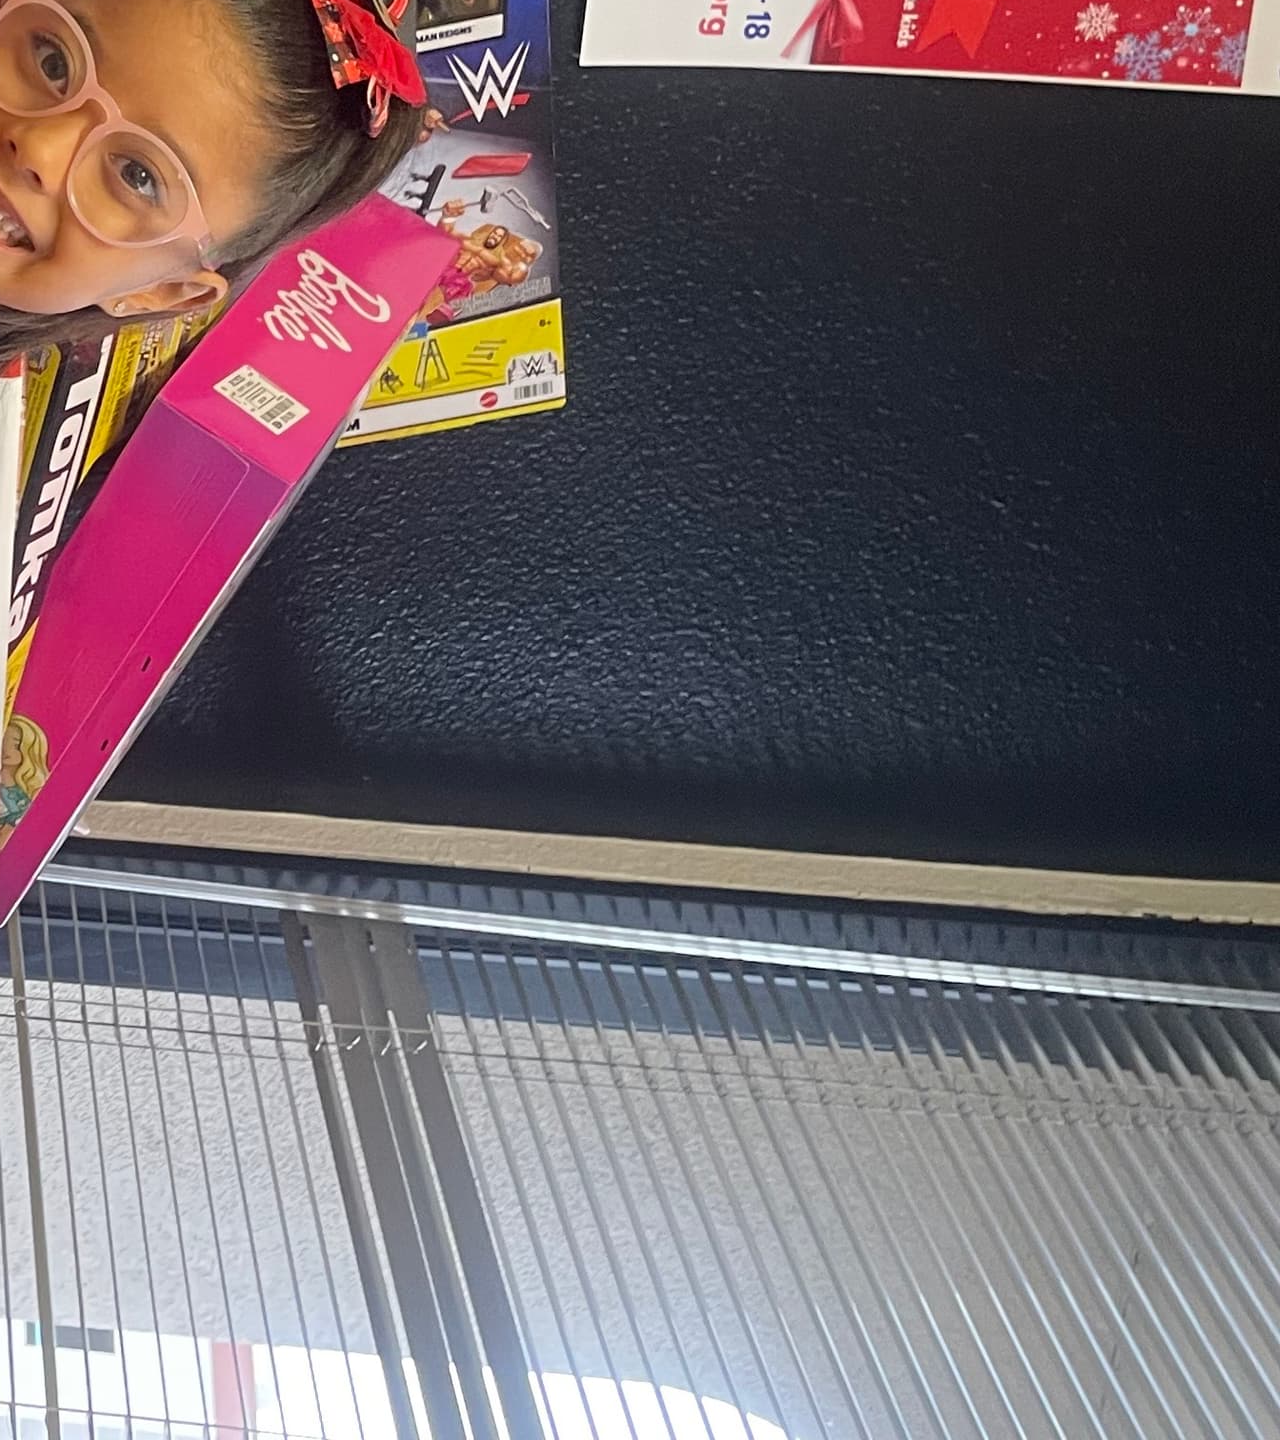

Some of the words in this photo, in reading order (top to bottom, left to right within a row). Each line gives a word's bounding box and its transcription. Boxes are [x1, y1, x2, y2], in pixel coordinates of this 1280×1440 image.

[743, 11, 771, 40] 18
[895, 14, 919, 48] kids
[262, 249, 391, 352] Barbie
[8, 335, 113, 643] Tonka
